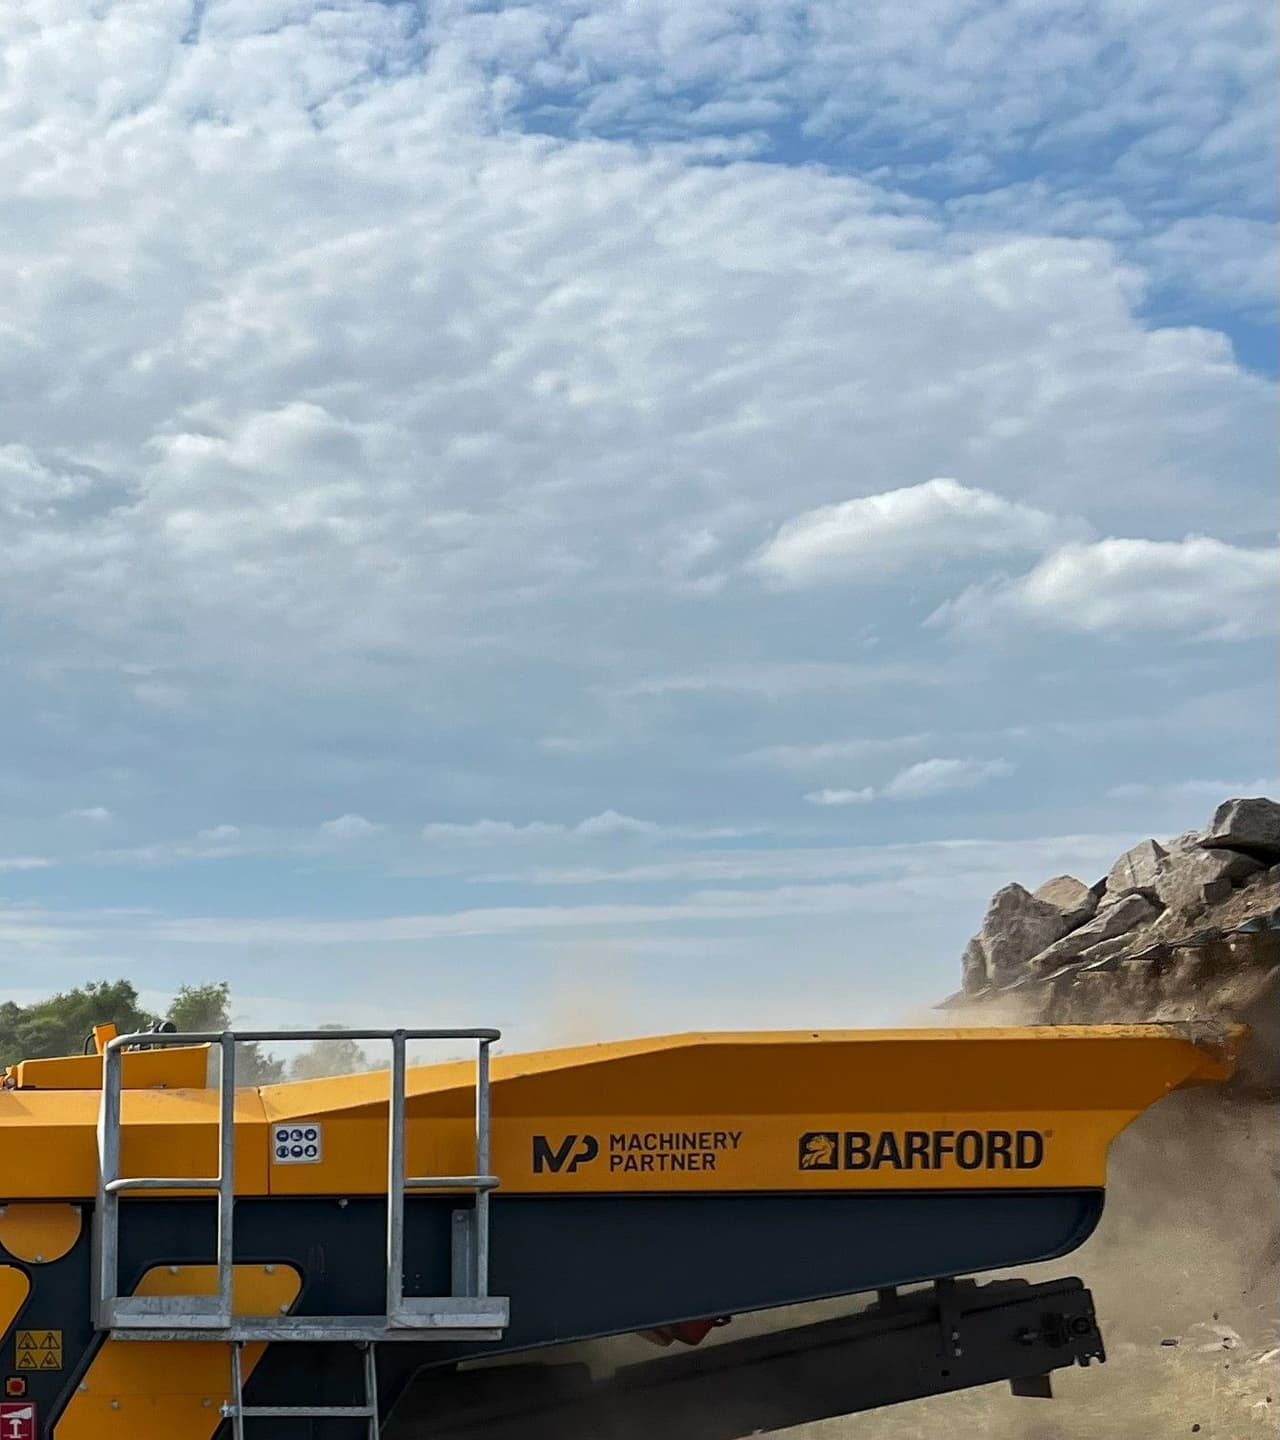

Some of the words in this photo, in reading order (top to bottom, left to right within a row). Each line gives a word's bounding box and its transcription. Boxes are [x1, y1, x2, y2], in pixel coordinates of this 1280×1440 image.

[533, 1135, 599, 1173] MP
[609, 1131, 742, 1151] MACHINERY
[844, 1130, 1044, 1170] BARFORD
[609, 1153, 716, 1172] PARTNER
